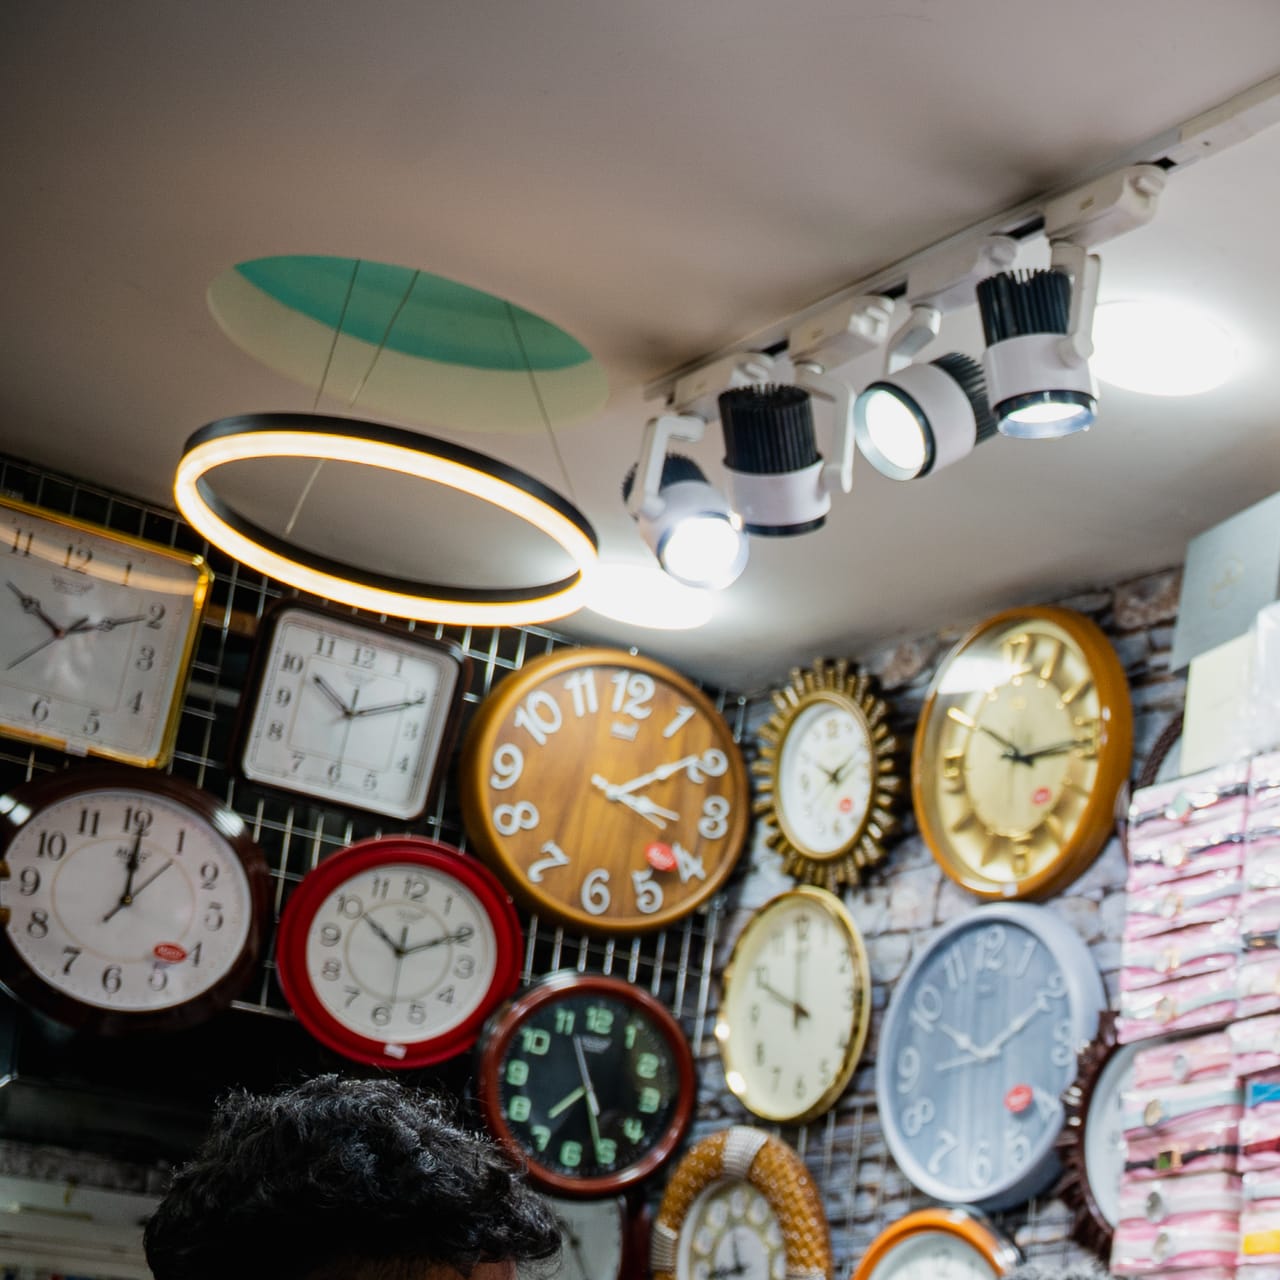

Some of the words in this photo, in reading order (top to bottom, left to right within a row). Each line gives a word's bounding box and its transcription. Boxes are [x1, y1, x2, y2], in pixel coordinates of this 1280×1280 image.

[564, 669, 599, 717] 11
[611, 670, 656, 719] 12
[514, 689, 563, 745] 10
[663, 705, 696, 738] 1
[490, 743, 524, 790] 9
[687, 748, 729, 784] 2
[78, 808, 100, 837] 11
[492, 801, 540, 836] 8
[698, 795, 730, 839] 3
[38, 831, 67, 861] 10
[177, 828, 185, 855] 1
[200, 862, 220, 890] 2
[527, 841, 571, 883] 7
[672, 841, 706, 884] 4
[19, 866, 40, 896] 9
[581, 868, 610, 915] 6
[632, 868, 664, 914] 5
[27, 910, 49, 938] 8
[63, 947, 81, 975] 7
[102, 965, 122, 993] 6
[555, 1007, 575, 1036] 11
[585, 1006, 614, 1035] 12
[520, 1026, 551, 1056] 10
[624, 1024, 637, 1050] 1
[506, 1059, 530, 1087] 9
[636, 1052, 660, 1079] 2
[508, 1095, 532, 1123] 8
[638, 1087, 661, 1114] 3
[531, 1124, 551, 1152] 7
[623, 1118, 645, 1145] 4
[560, 1140, 583, 1167] 6
[598, 1138, 618, 1165] 5
